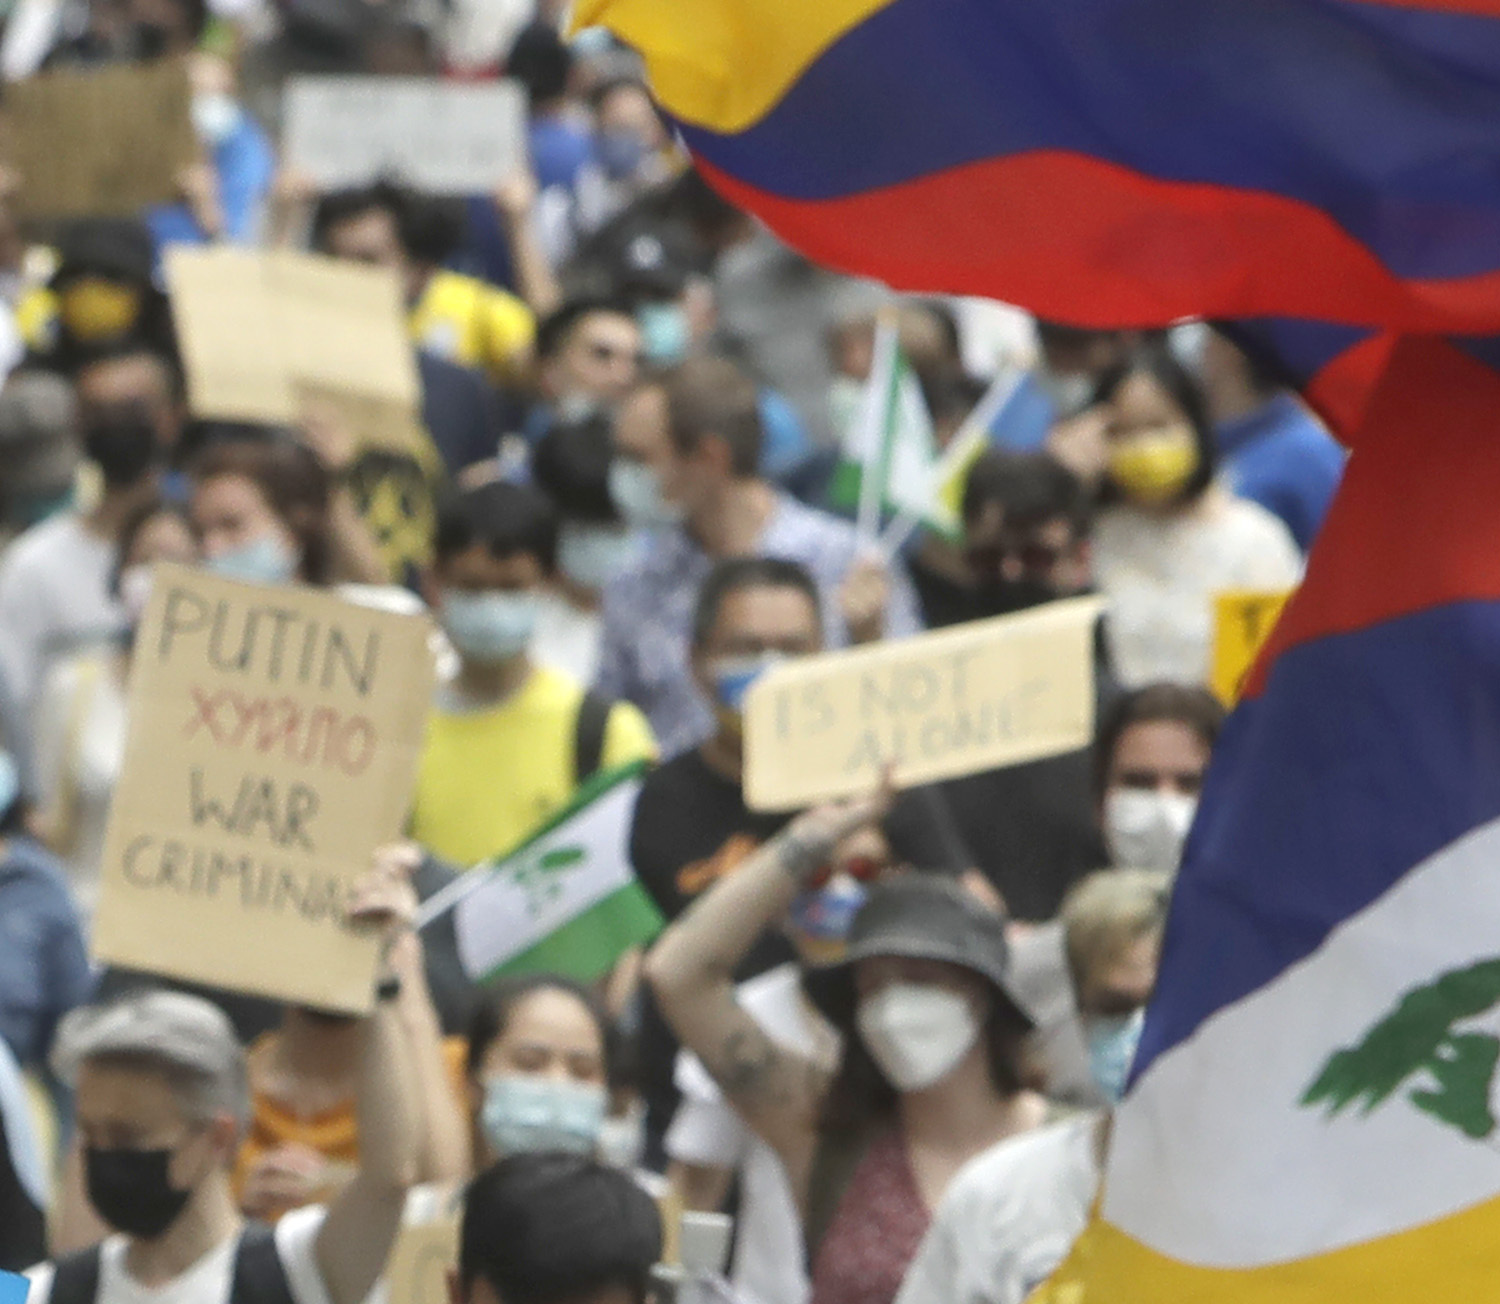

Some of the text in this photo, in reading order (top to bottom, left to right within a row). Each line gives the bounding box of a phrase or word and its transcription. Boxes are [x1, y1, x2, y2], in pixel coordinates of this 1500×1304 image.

[157, 587, 383, 698] PUTIN
[774, 648, 984, 746] IS NOT
[189, 763, 321, 852] WAR
[122, 834, 358, 926] CRIMINA
